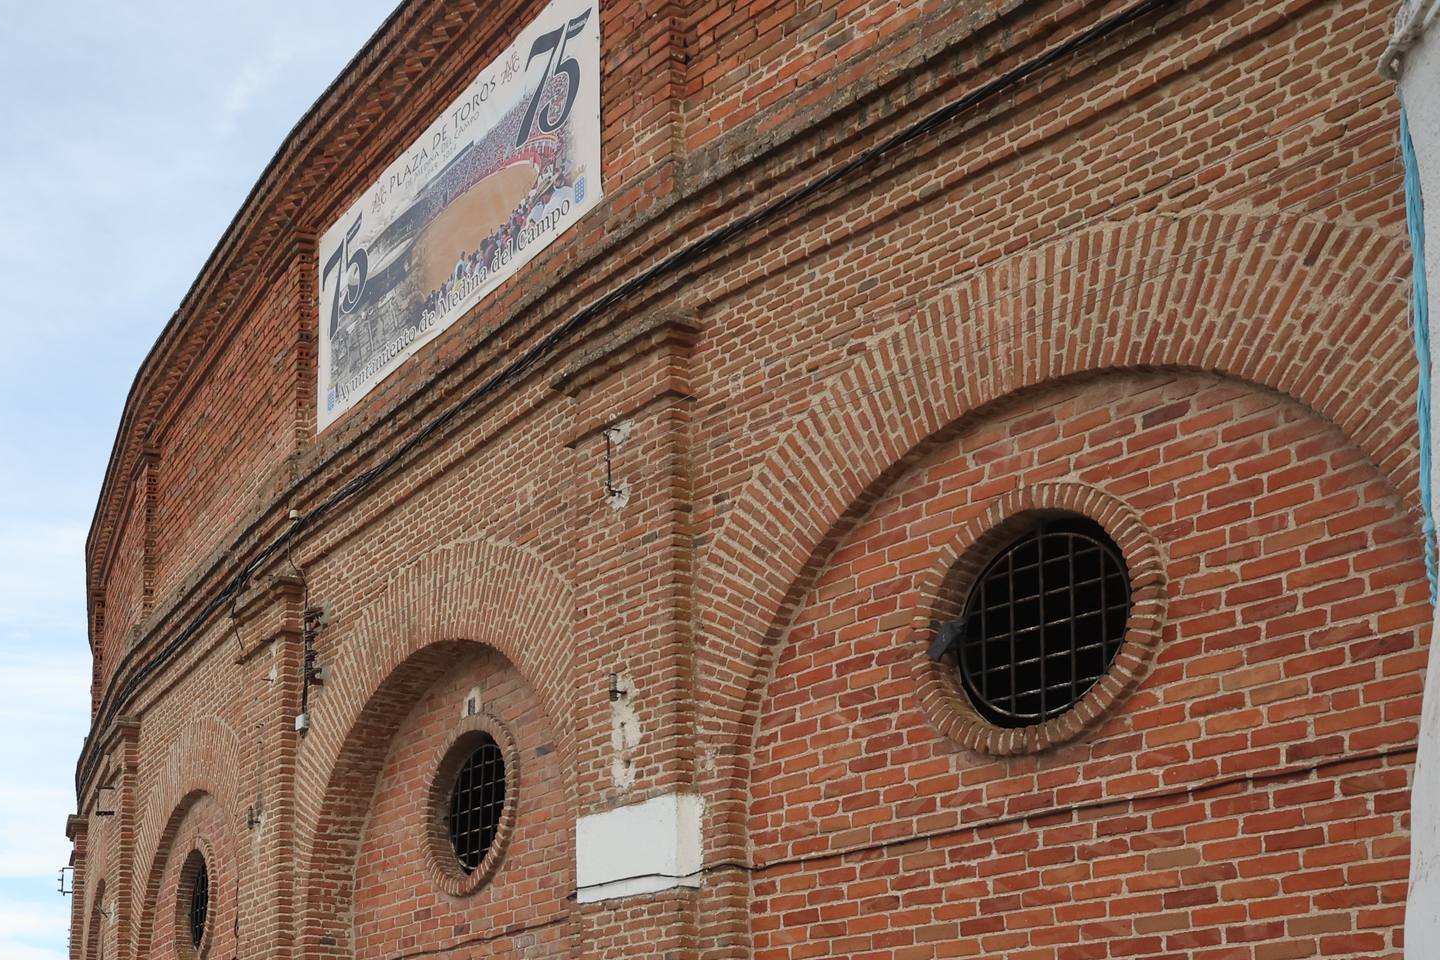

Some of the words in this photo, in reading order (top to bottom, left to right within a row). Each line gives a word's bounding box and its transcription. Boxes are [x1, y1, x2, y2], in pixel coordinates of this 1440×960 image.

[389, 147, 428, 191] PLAZA
[433, 124, 448, 149] DE
[452, 80, 496, 129] TOROS
[515, 7, 592, 148] 75
[414, 149, 439, 179] MEDINA
[441, 138, 452, 154] DEL
[453, 111, 480, 140] CAMPO
[322, 211, 368, 340] 75
[337, 325, 416, 399] Ayuntamiento
[419, 309, 435, 334] de
[438, 270, 488, 319] Medina
[491, 240, 513, 273] del
[517, 199, 570, 251] Campo
